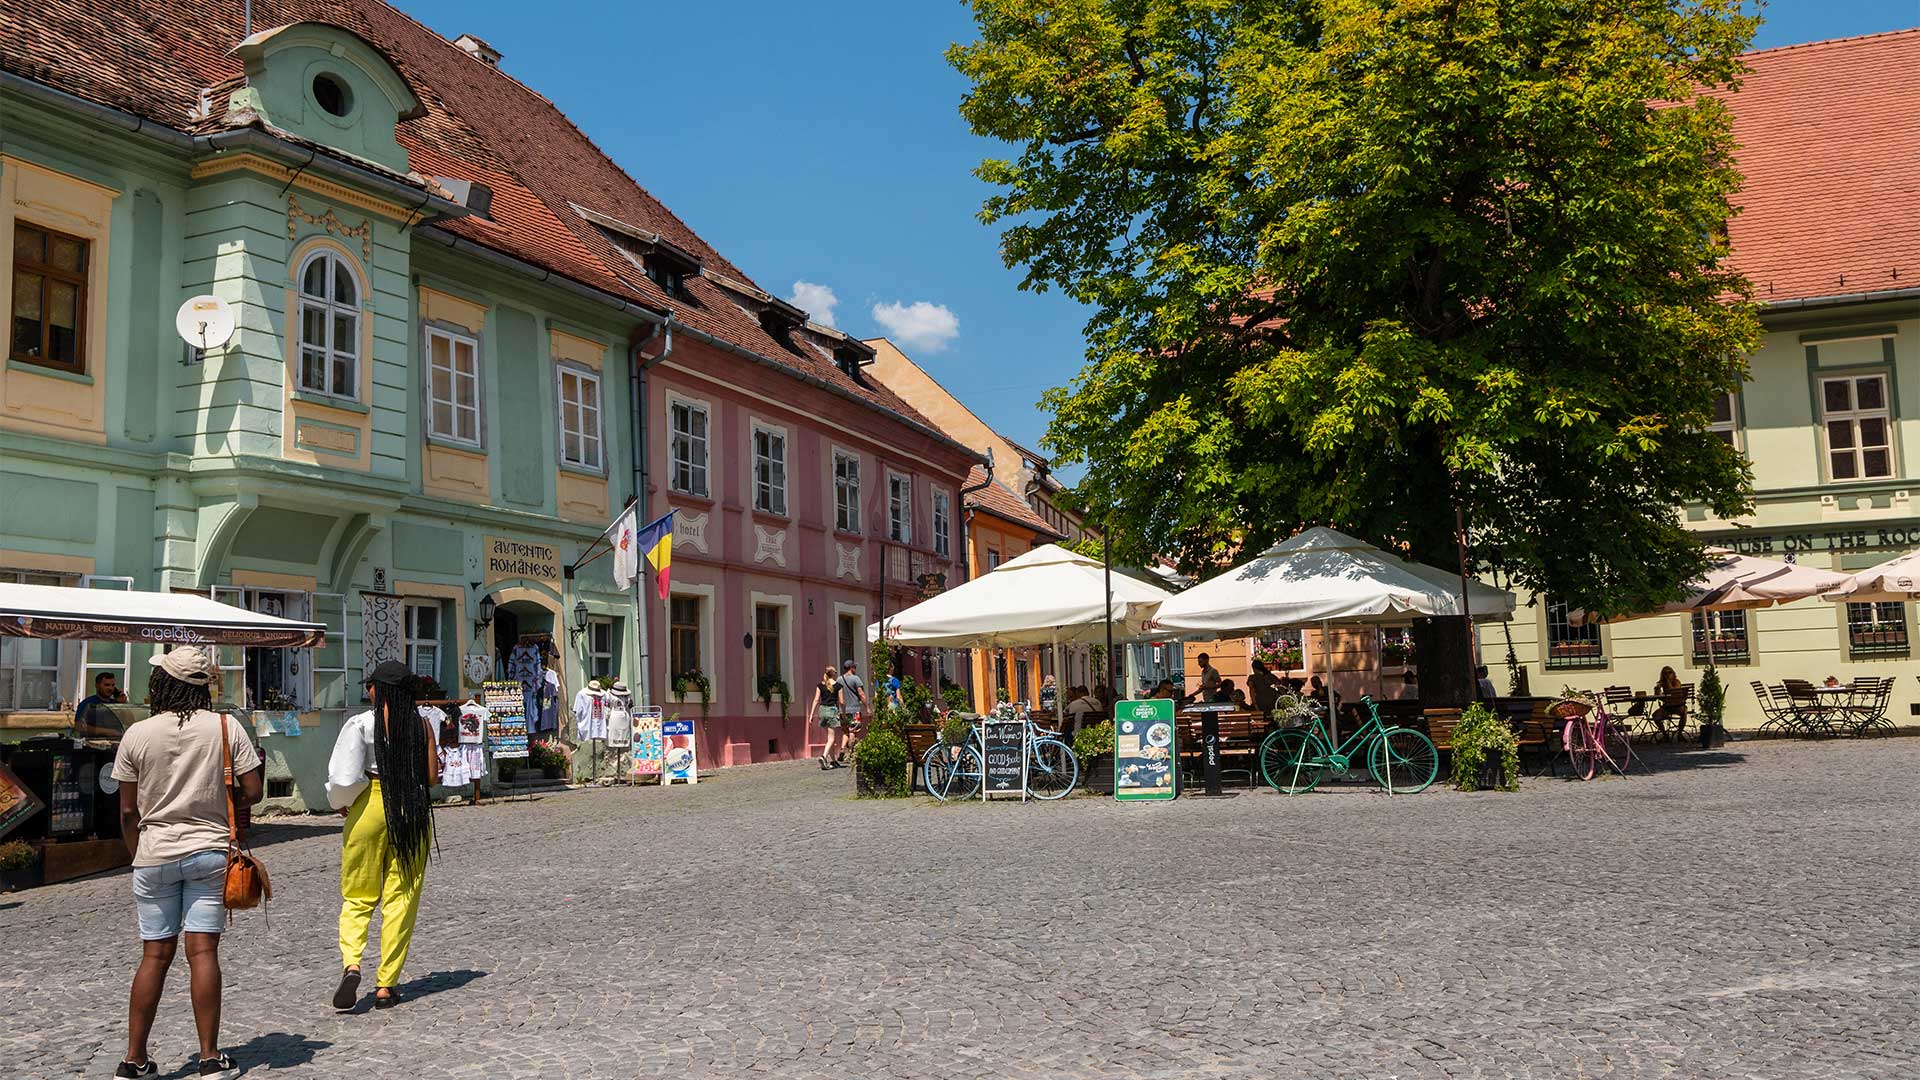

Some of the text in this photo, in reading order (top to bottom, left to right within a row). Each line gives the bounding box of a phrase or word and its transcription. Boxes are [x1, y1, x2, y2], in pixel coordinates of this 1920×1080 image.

[680, 523, 699, 537] hotel
[1784, 534, 1813, 550] ON
[1824, 531, 1867, 549] THE
[45, 622, 128, 634] NATURAL SPECIAL
[141, 626, 196, 641] argelato
[222, 630, 260, 639] DELICIOUS
[374, 596, 389, 663] SOUVE
[1207, 745, 1216, 766] pepsi
